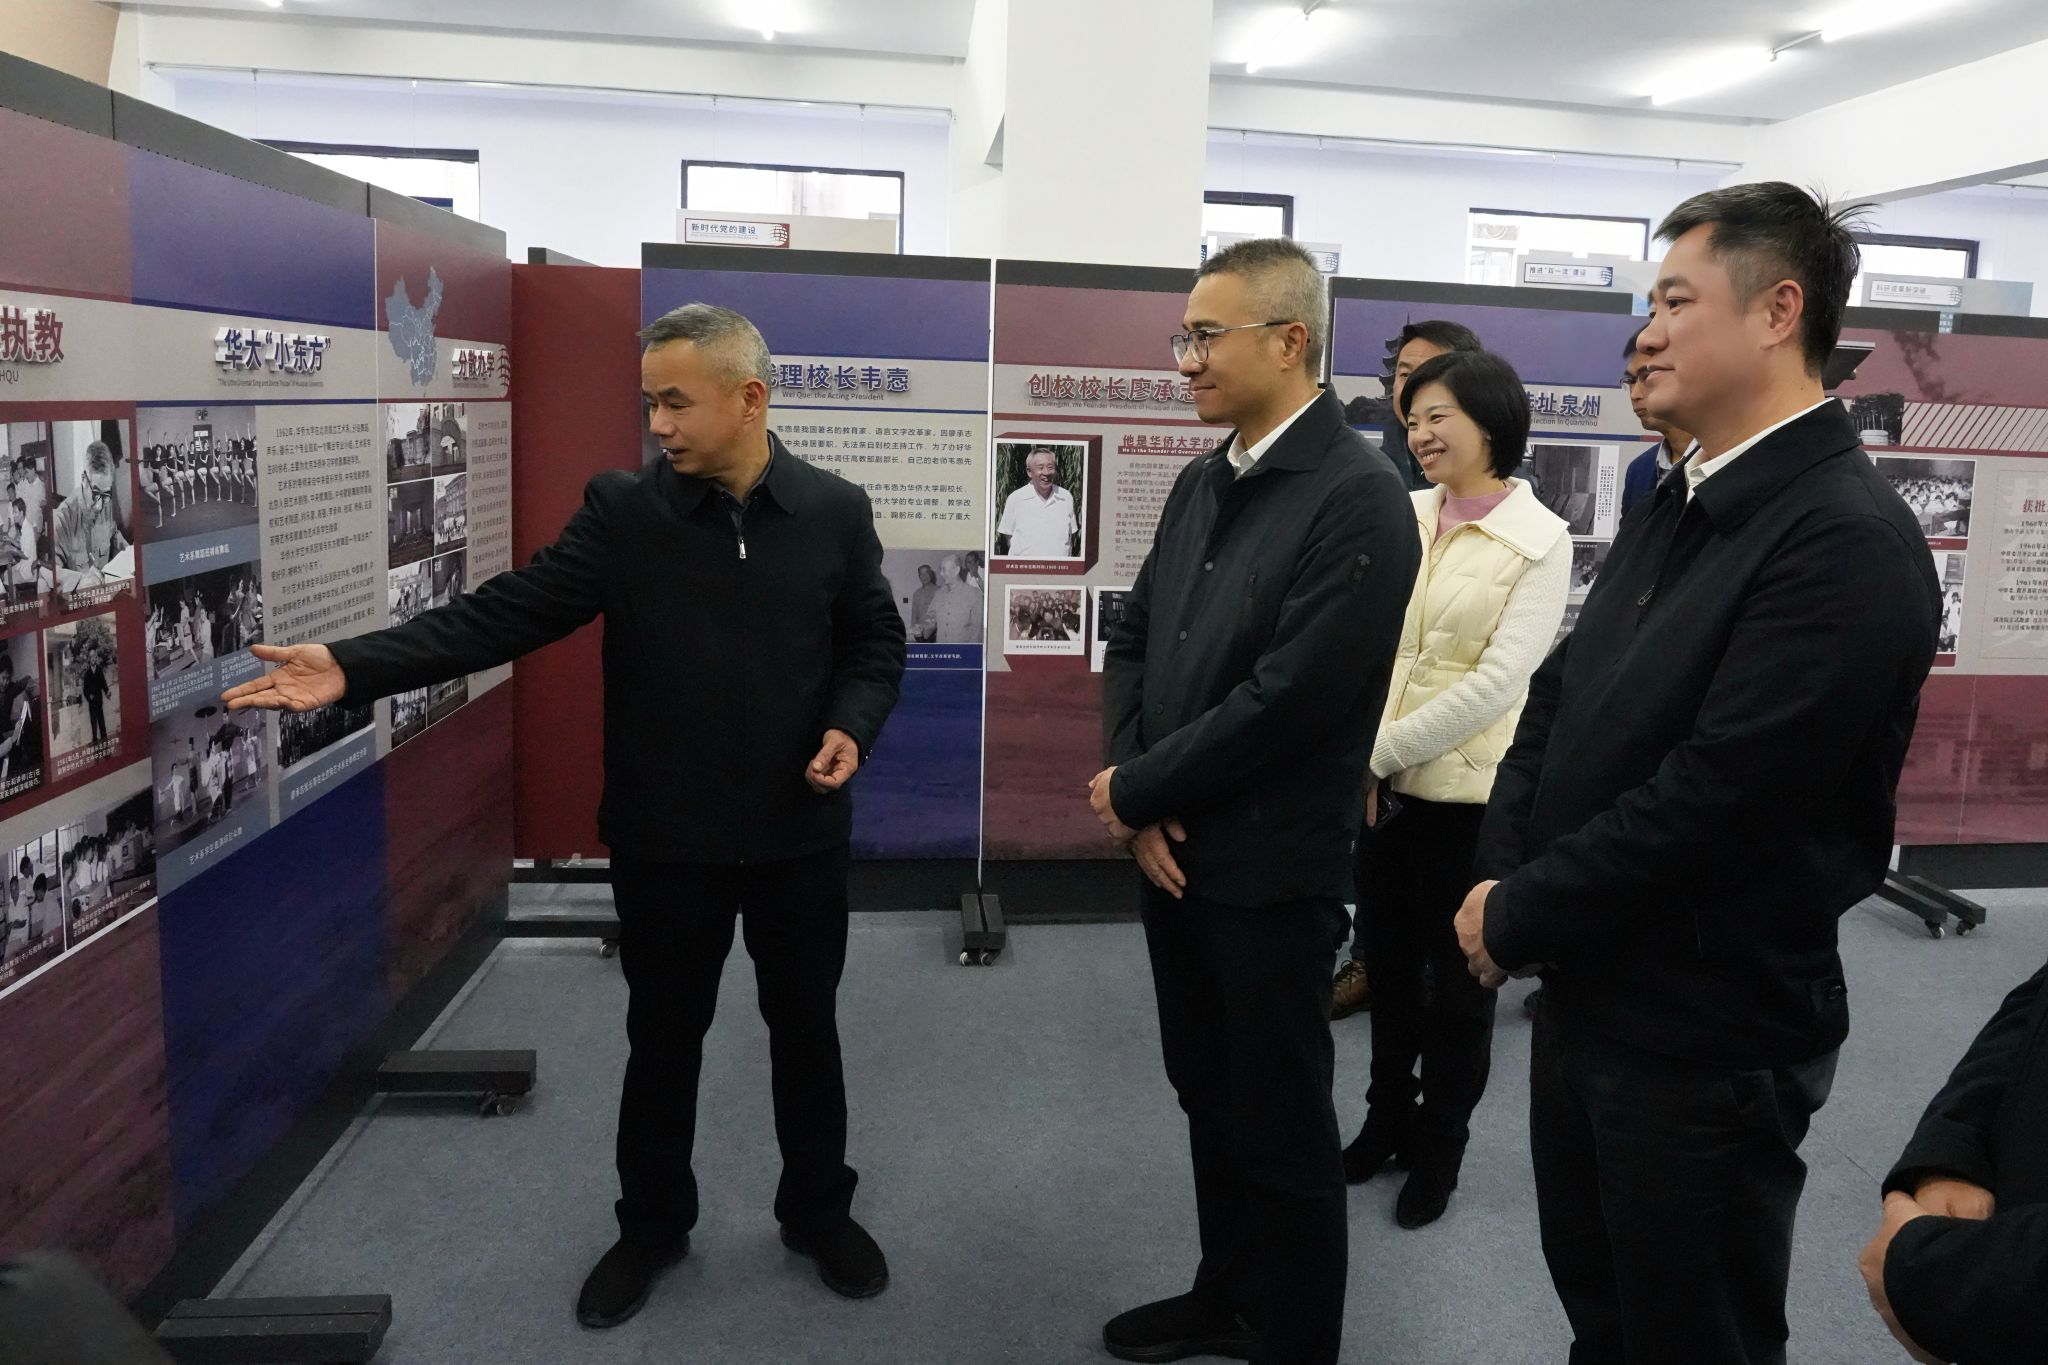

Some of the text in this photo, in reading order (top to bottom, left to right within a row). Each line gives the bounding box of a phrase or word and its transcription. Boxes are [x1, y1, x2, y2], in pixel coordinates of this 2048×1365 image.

[691, 223, 756, 234] 新时代党的建设
[0, 306, 64, 361] 执教
[458, 348, 495, 377] 分散办学
[0, 369, 19, 385] HQU
[1028, 373, 1195, 403] 创校校长廖承志
[827, 392, 850, 401] Acting
[851, 393, 884, 401] President
[1533, 418, 1555, 426] lection
